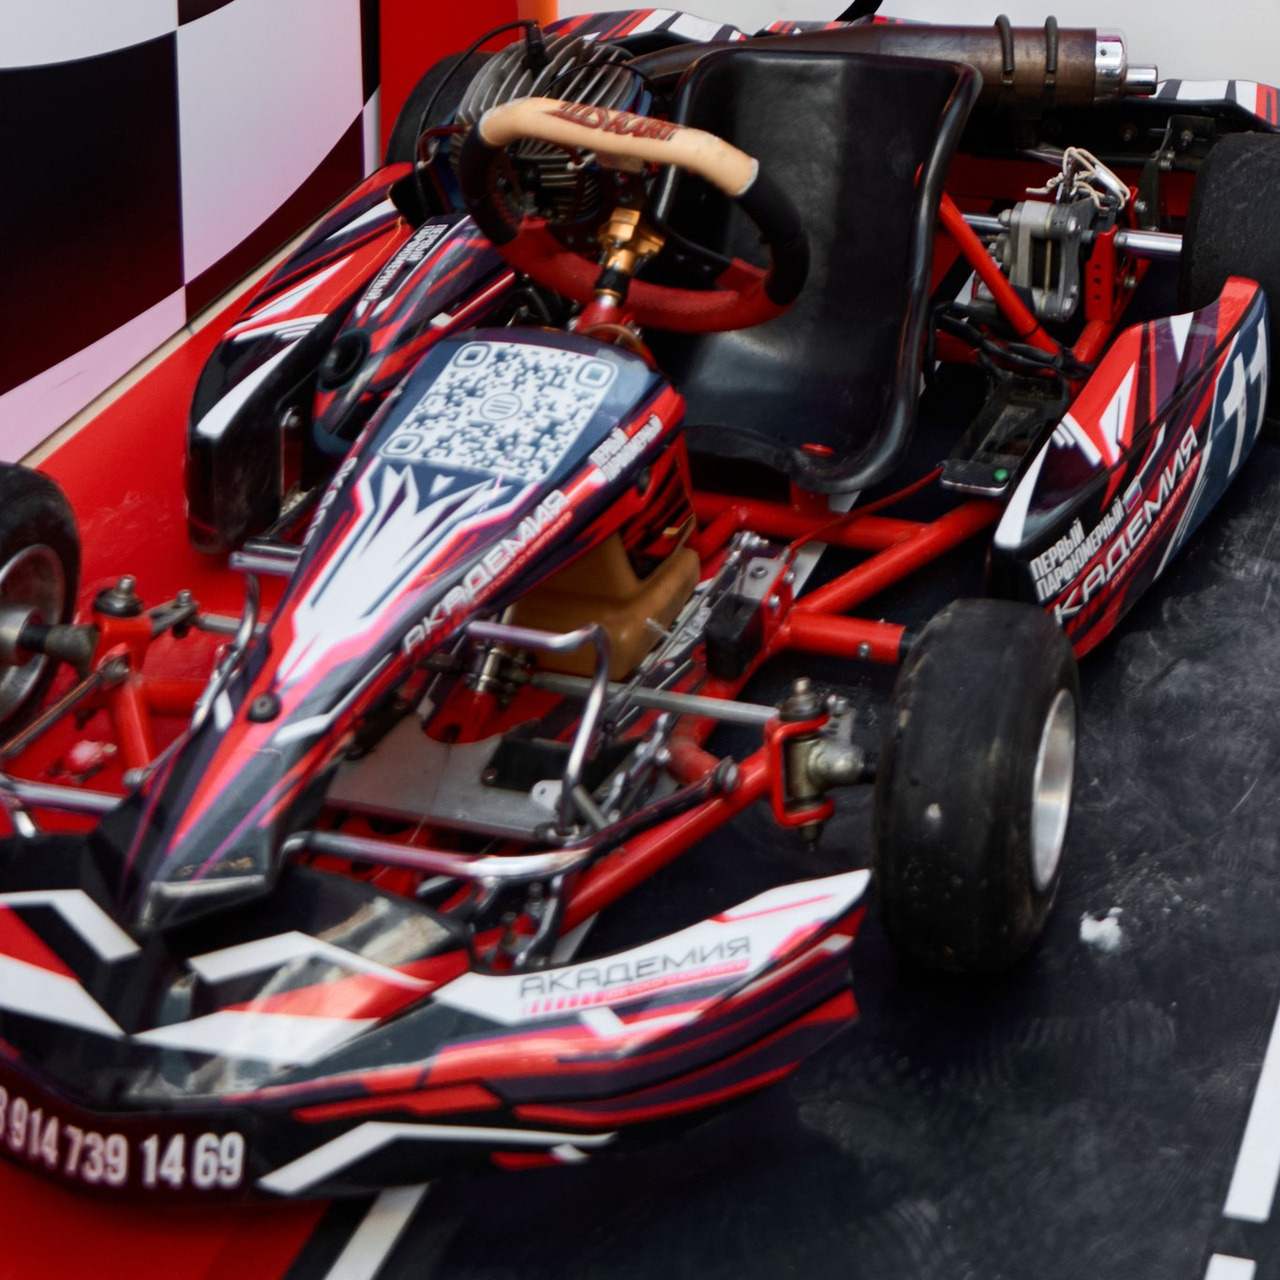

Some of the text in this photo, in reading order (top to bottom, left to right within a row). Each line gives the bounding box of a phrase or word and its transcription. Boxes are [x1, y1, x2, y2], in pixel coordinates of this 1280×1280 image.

[404, 489, 572, 655] АКАДЕМИЯ
[1029, 517, 1085, 581] ПЕРВЫЙ
[1036, 496, 1125, 602] ПАРФЮМЕРНЫЙ
[1054, 424, 1199, 627] КАДЕМИЯ
[519, 936, 750, 998] АКАДЕМИЯ
[10, 1096, 59, 1166] 914
[65, 1124, 129, 1184] 739
[140, 1133, 186, 1188] 14
[192, 1131, 245, 1188] 69
